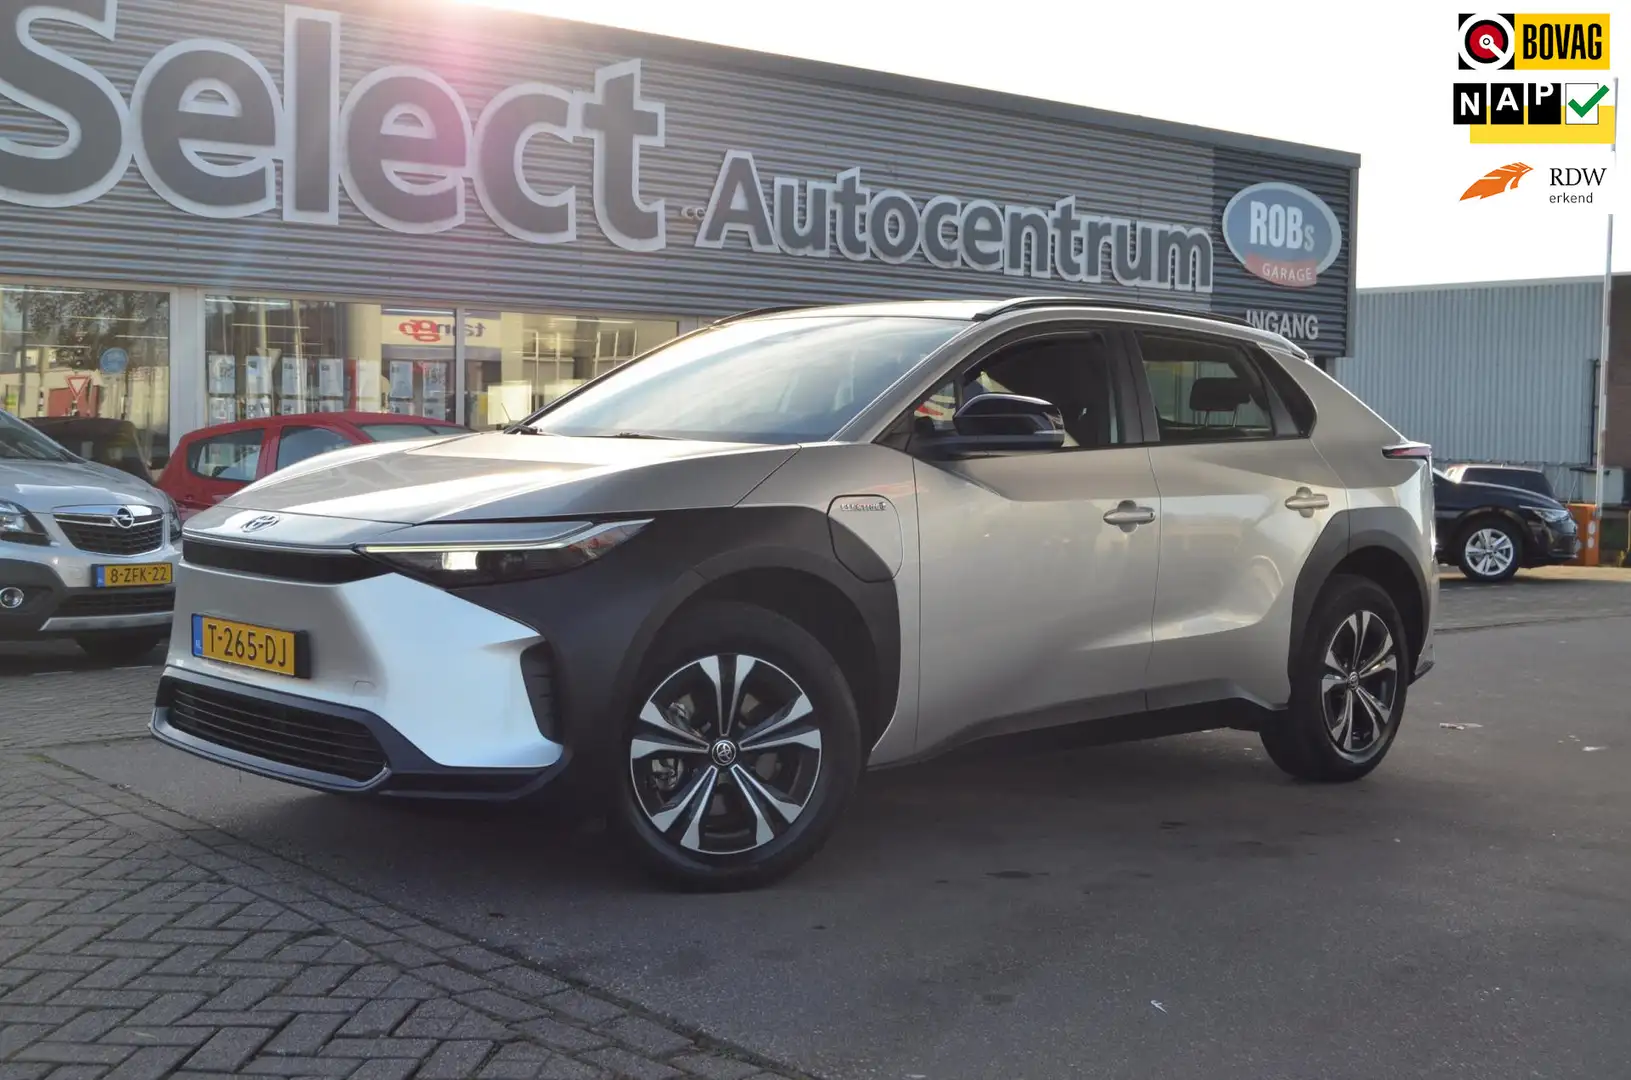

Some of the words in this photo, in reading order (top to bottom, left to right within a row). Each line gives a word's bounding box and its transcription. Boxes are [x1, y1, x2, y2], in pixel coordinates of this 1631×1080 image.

[0, 0, 666, 252] Select
[694, 148, 1214, 293] Autocentrum
[1250, 201, 1315, 252] ROBs
[1261, 263, 1312, 282] GARAGE
[207, 624, 286, 667] T-265-DJ
